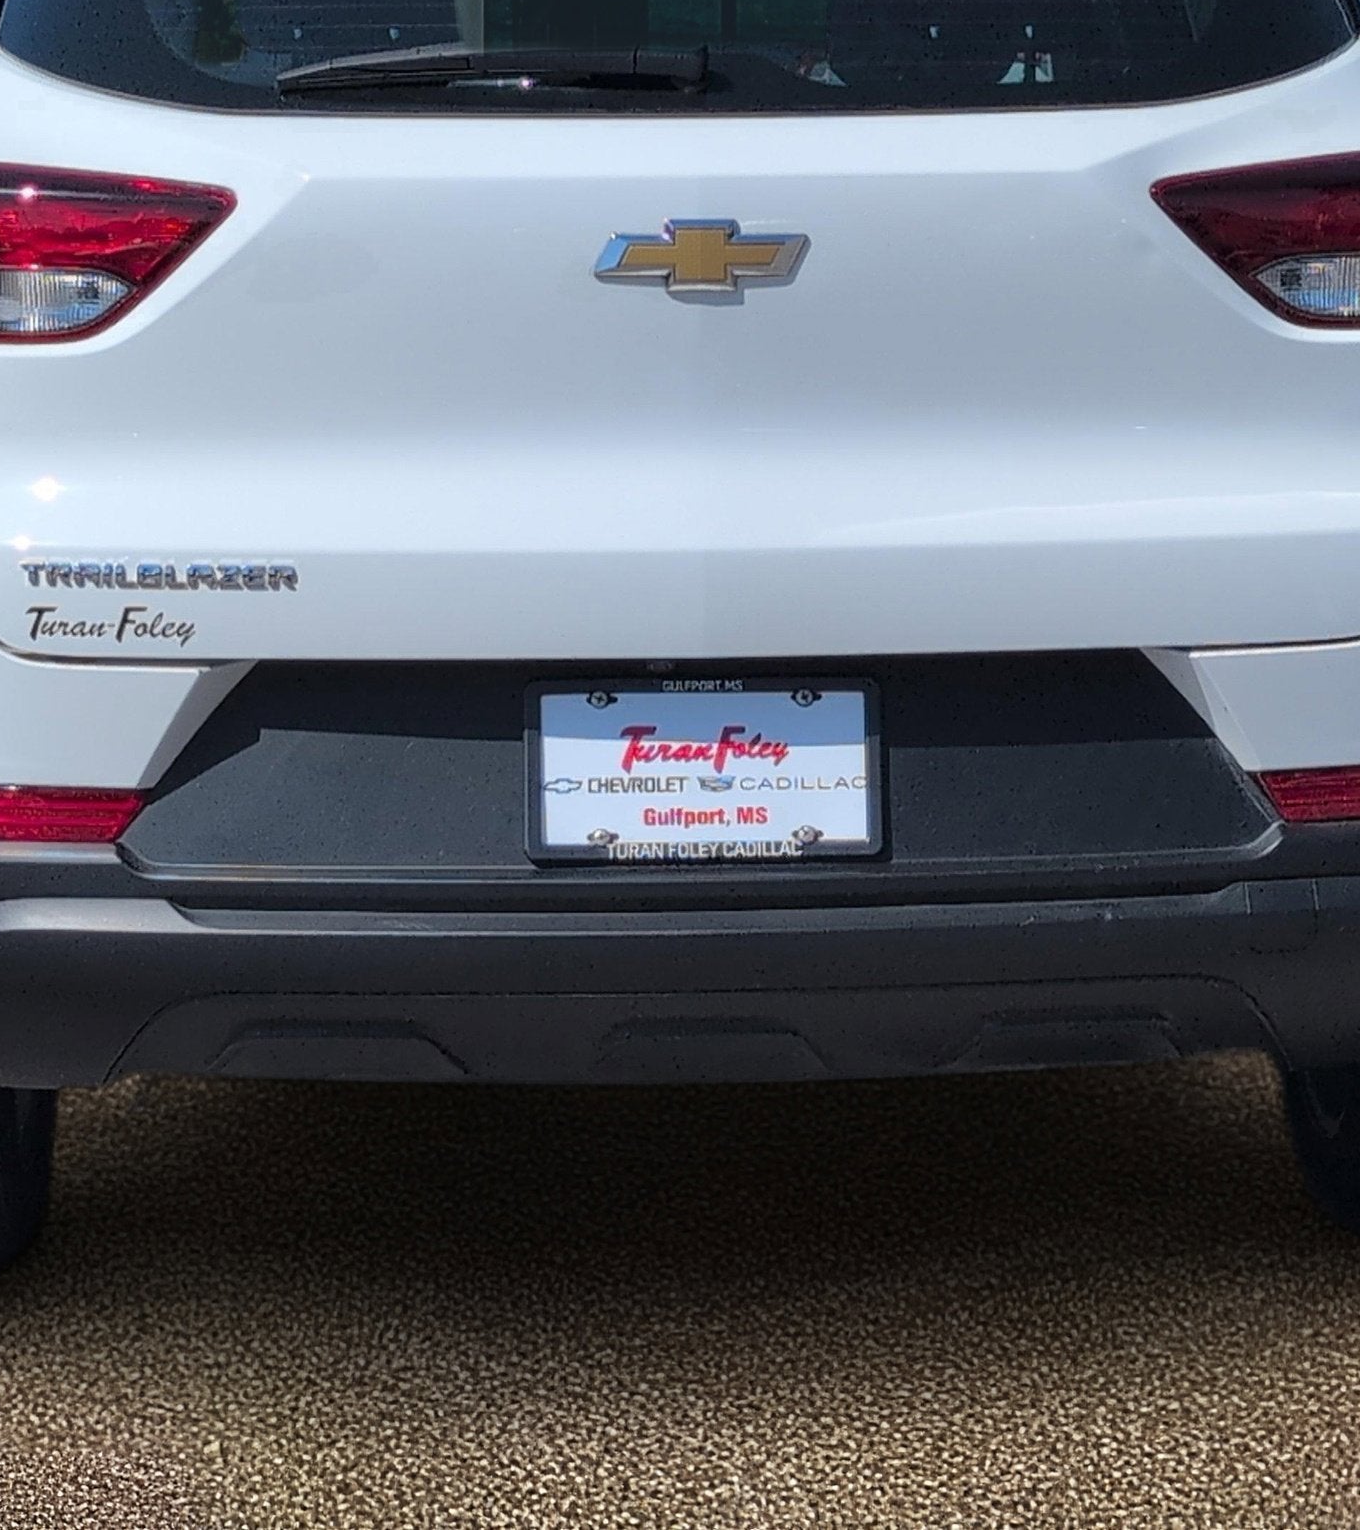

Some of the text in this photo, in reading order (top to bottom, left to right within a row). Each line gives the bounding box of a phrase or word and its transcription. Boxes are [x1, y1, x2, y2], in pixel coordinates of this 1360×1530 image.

[20, 558, 299, 591] TRAILBLAZER
[588, 776, 867, 794] CHEVROLET CADILLAC
[643, 806, 769, 829] Gulfport, MS
[605, 838, 805, 860] TURAN FOLEY CADILLAC
